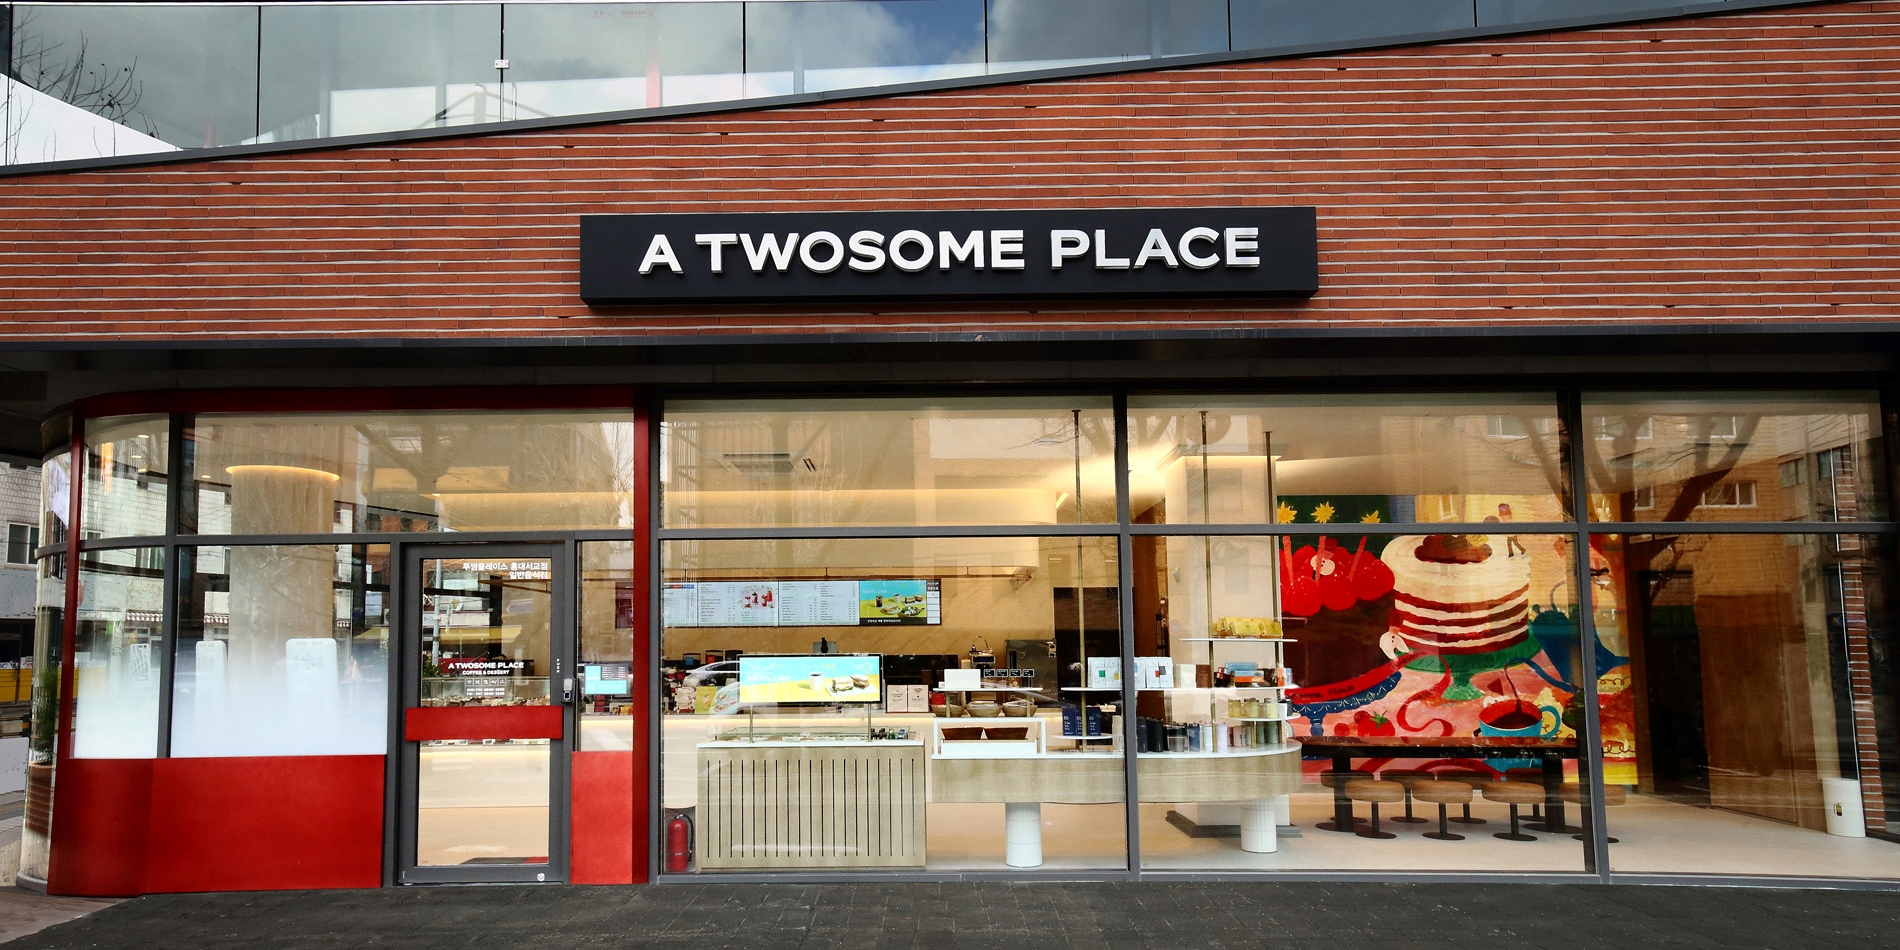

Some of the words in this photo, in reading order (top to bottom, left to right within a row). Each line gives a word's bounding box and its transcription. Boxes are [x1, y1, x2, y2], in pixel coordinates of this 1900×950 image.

[638, 234, 684, 275] A
[695, 229, 1025, 274] TWOSOME
[1050, 226, 1261, 270] PLACE
[462, 562, 508, 571] 투썸플레이스
[510, 562, 548, 571] 홍대서교점
[509, 571, 548, 579] 일반음식점
